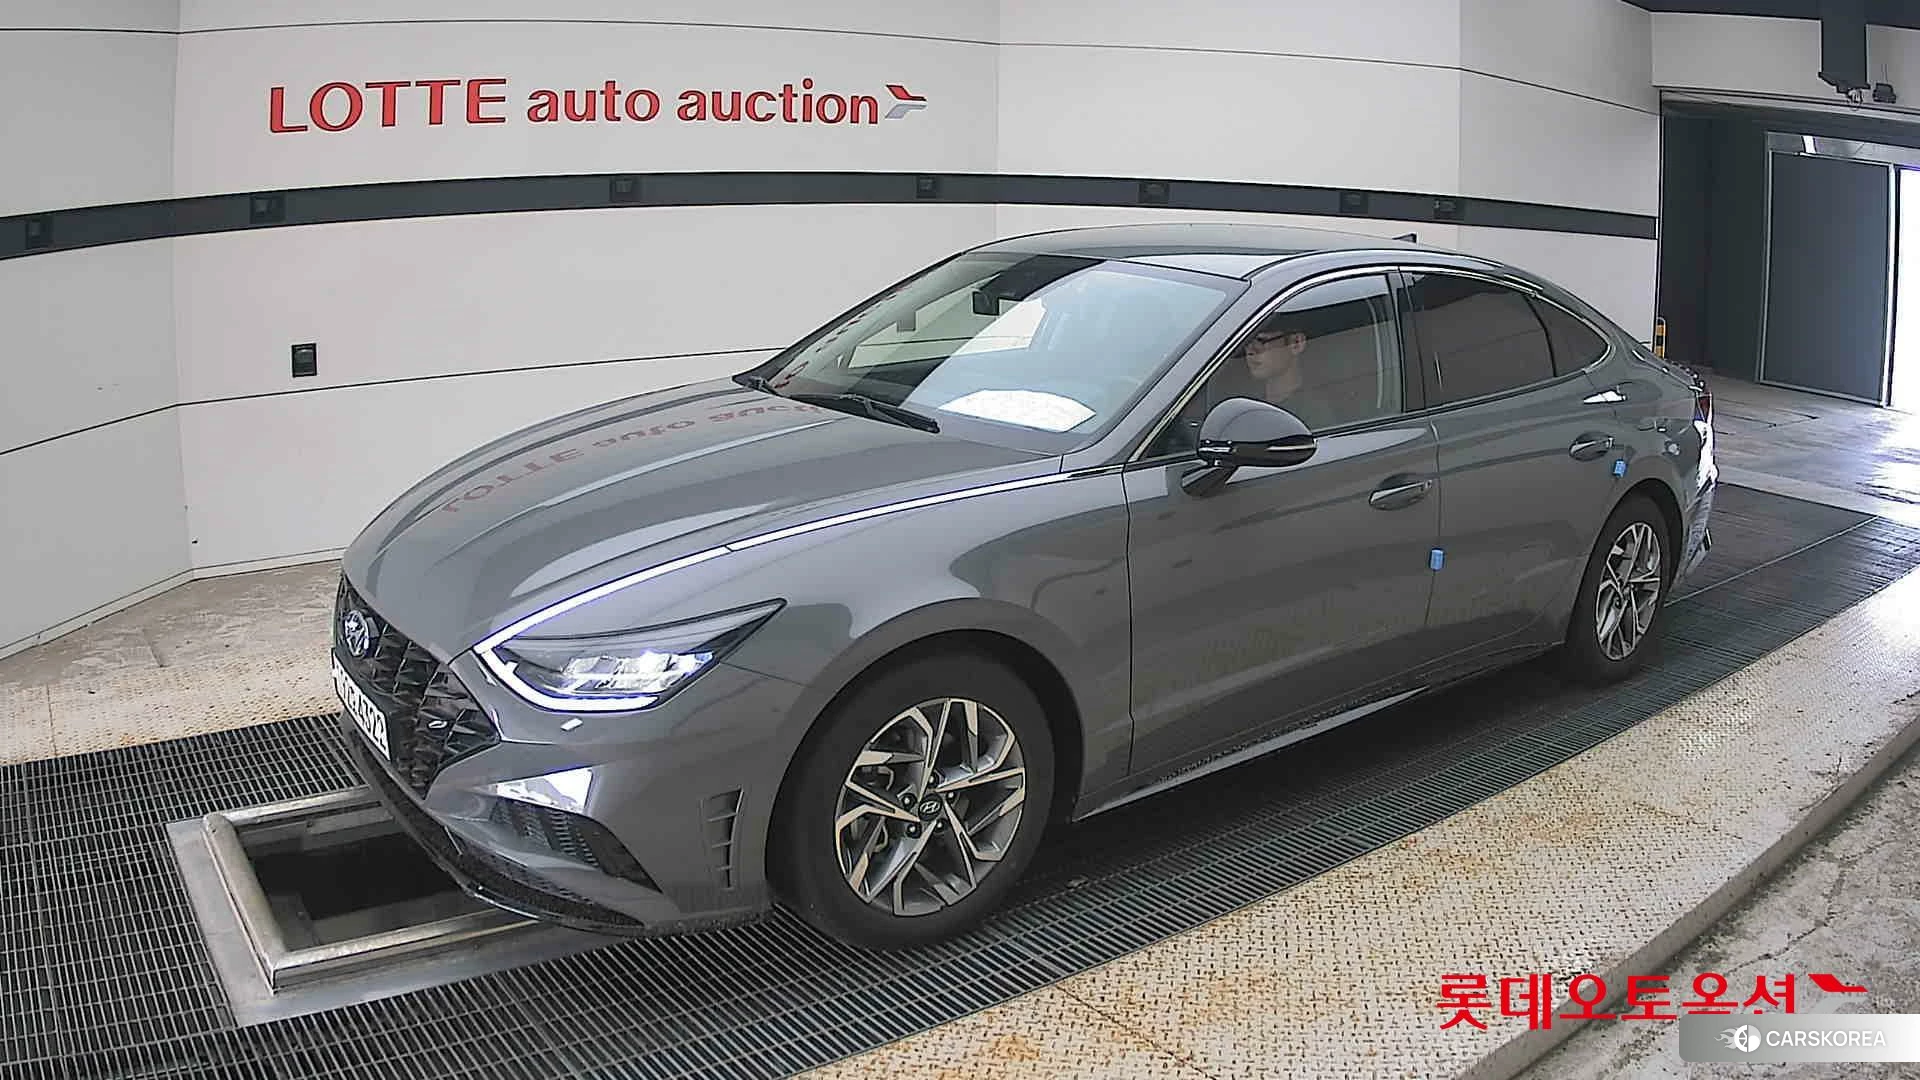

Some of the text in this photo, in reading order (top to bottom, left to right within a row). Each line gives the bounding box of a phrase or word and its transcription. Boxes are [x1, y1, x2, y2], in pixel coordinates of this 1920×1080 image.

[269, 77, 879, 134] LOTTE auto auction
